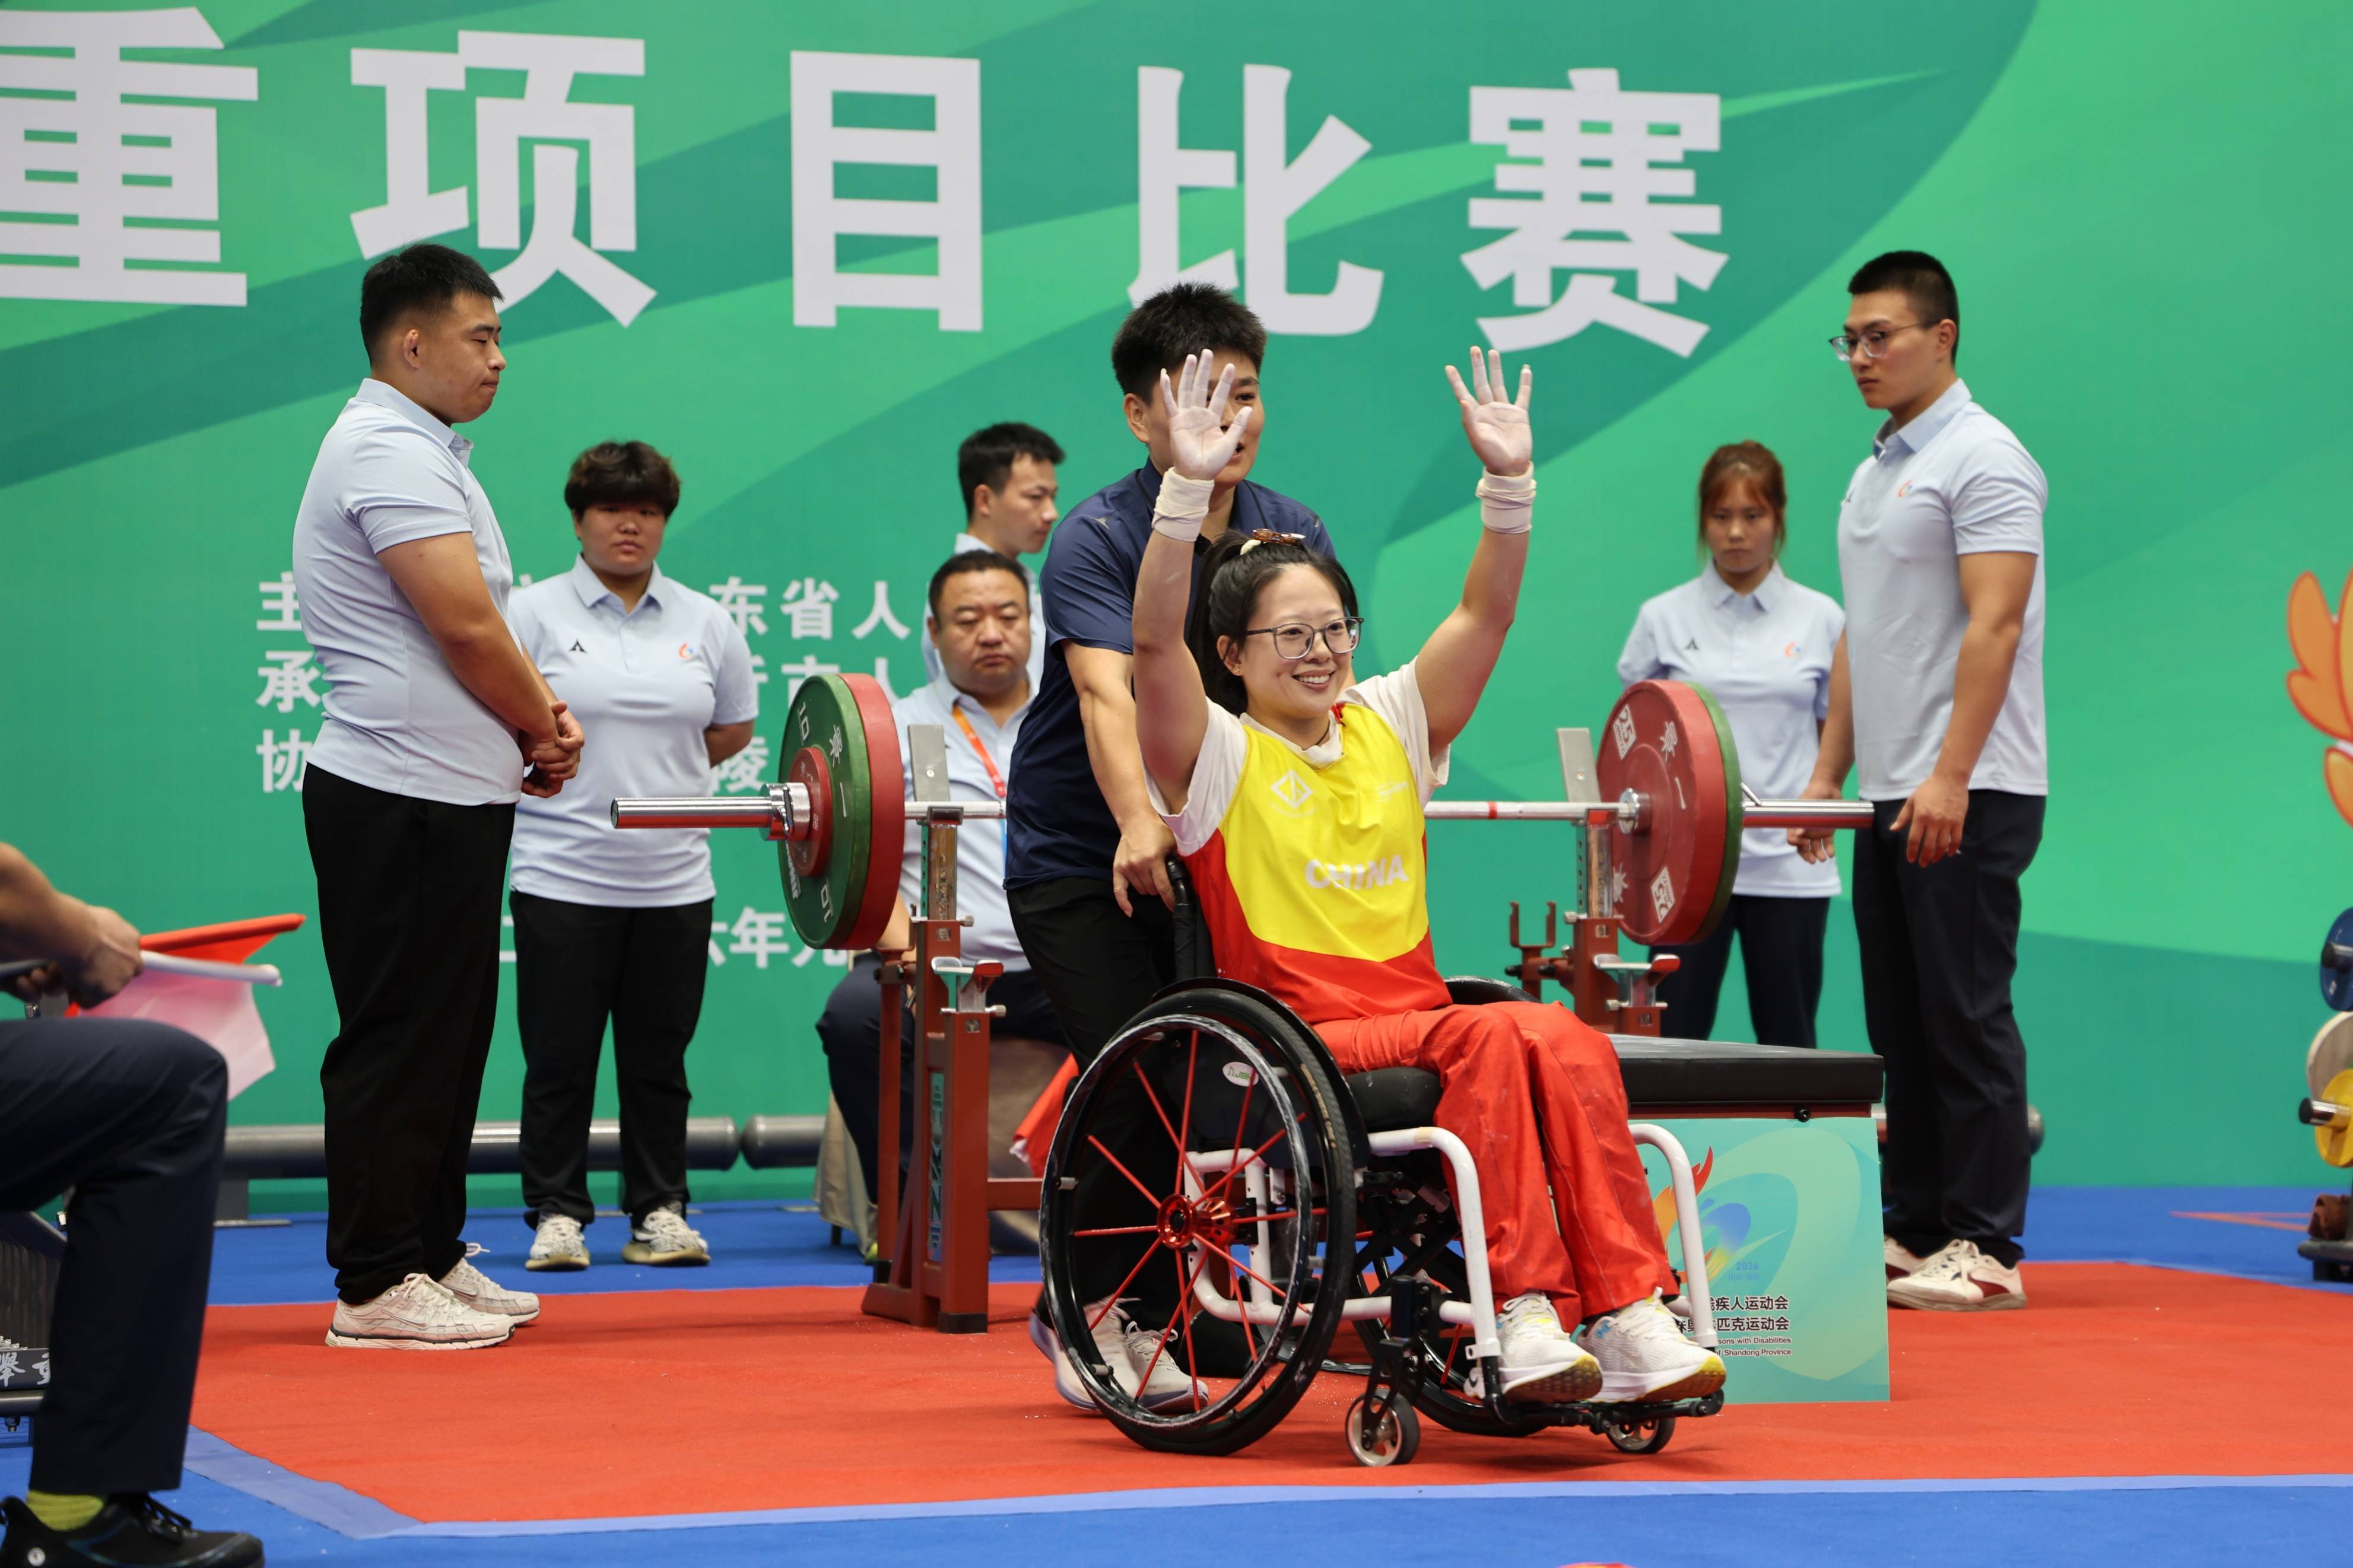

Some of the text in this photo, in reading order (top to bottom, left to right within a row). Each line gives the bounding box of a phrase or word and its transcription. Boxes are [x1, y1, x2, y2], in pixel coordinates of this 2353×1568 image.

[0, 7, 1729, 359] 重项目比赛
[1306, 854, 1409, 890] CHINA
[1736, 1262, 1759, 1270] 2026
[1754, 1336, 1791, 1344] Disabilities
[1724, 1348, 1760, 1357] Shandong
